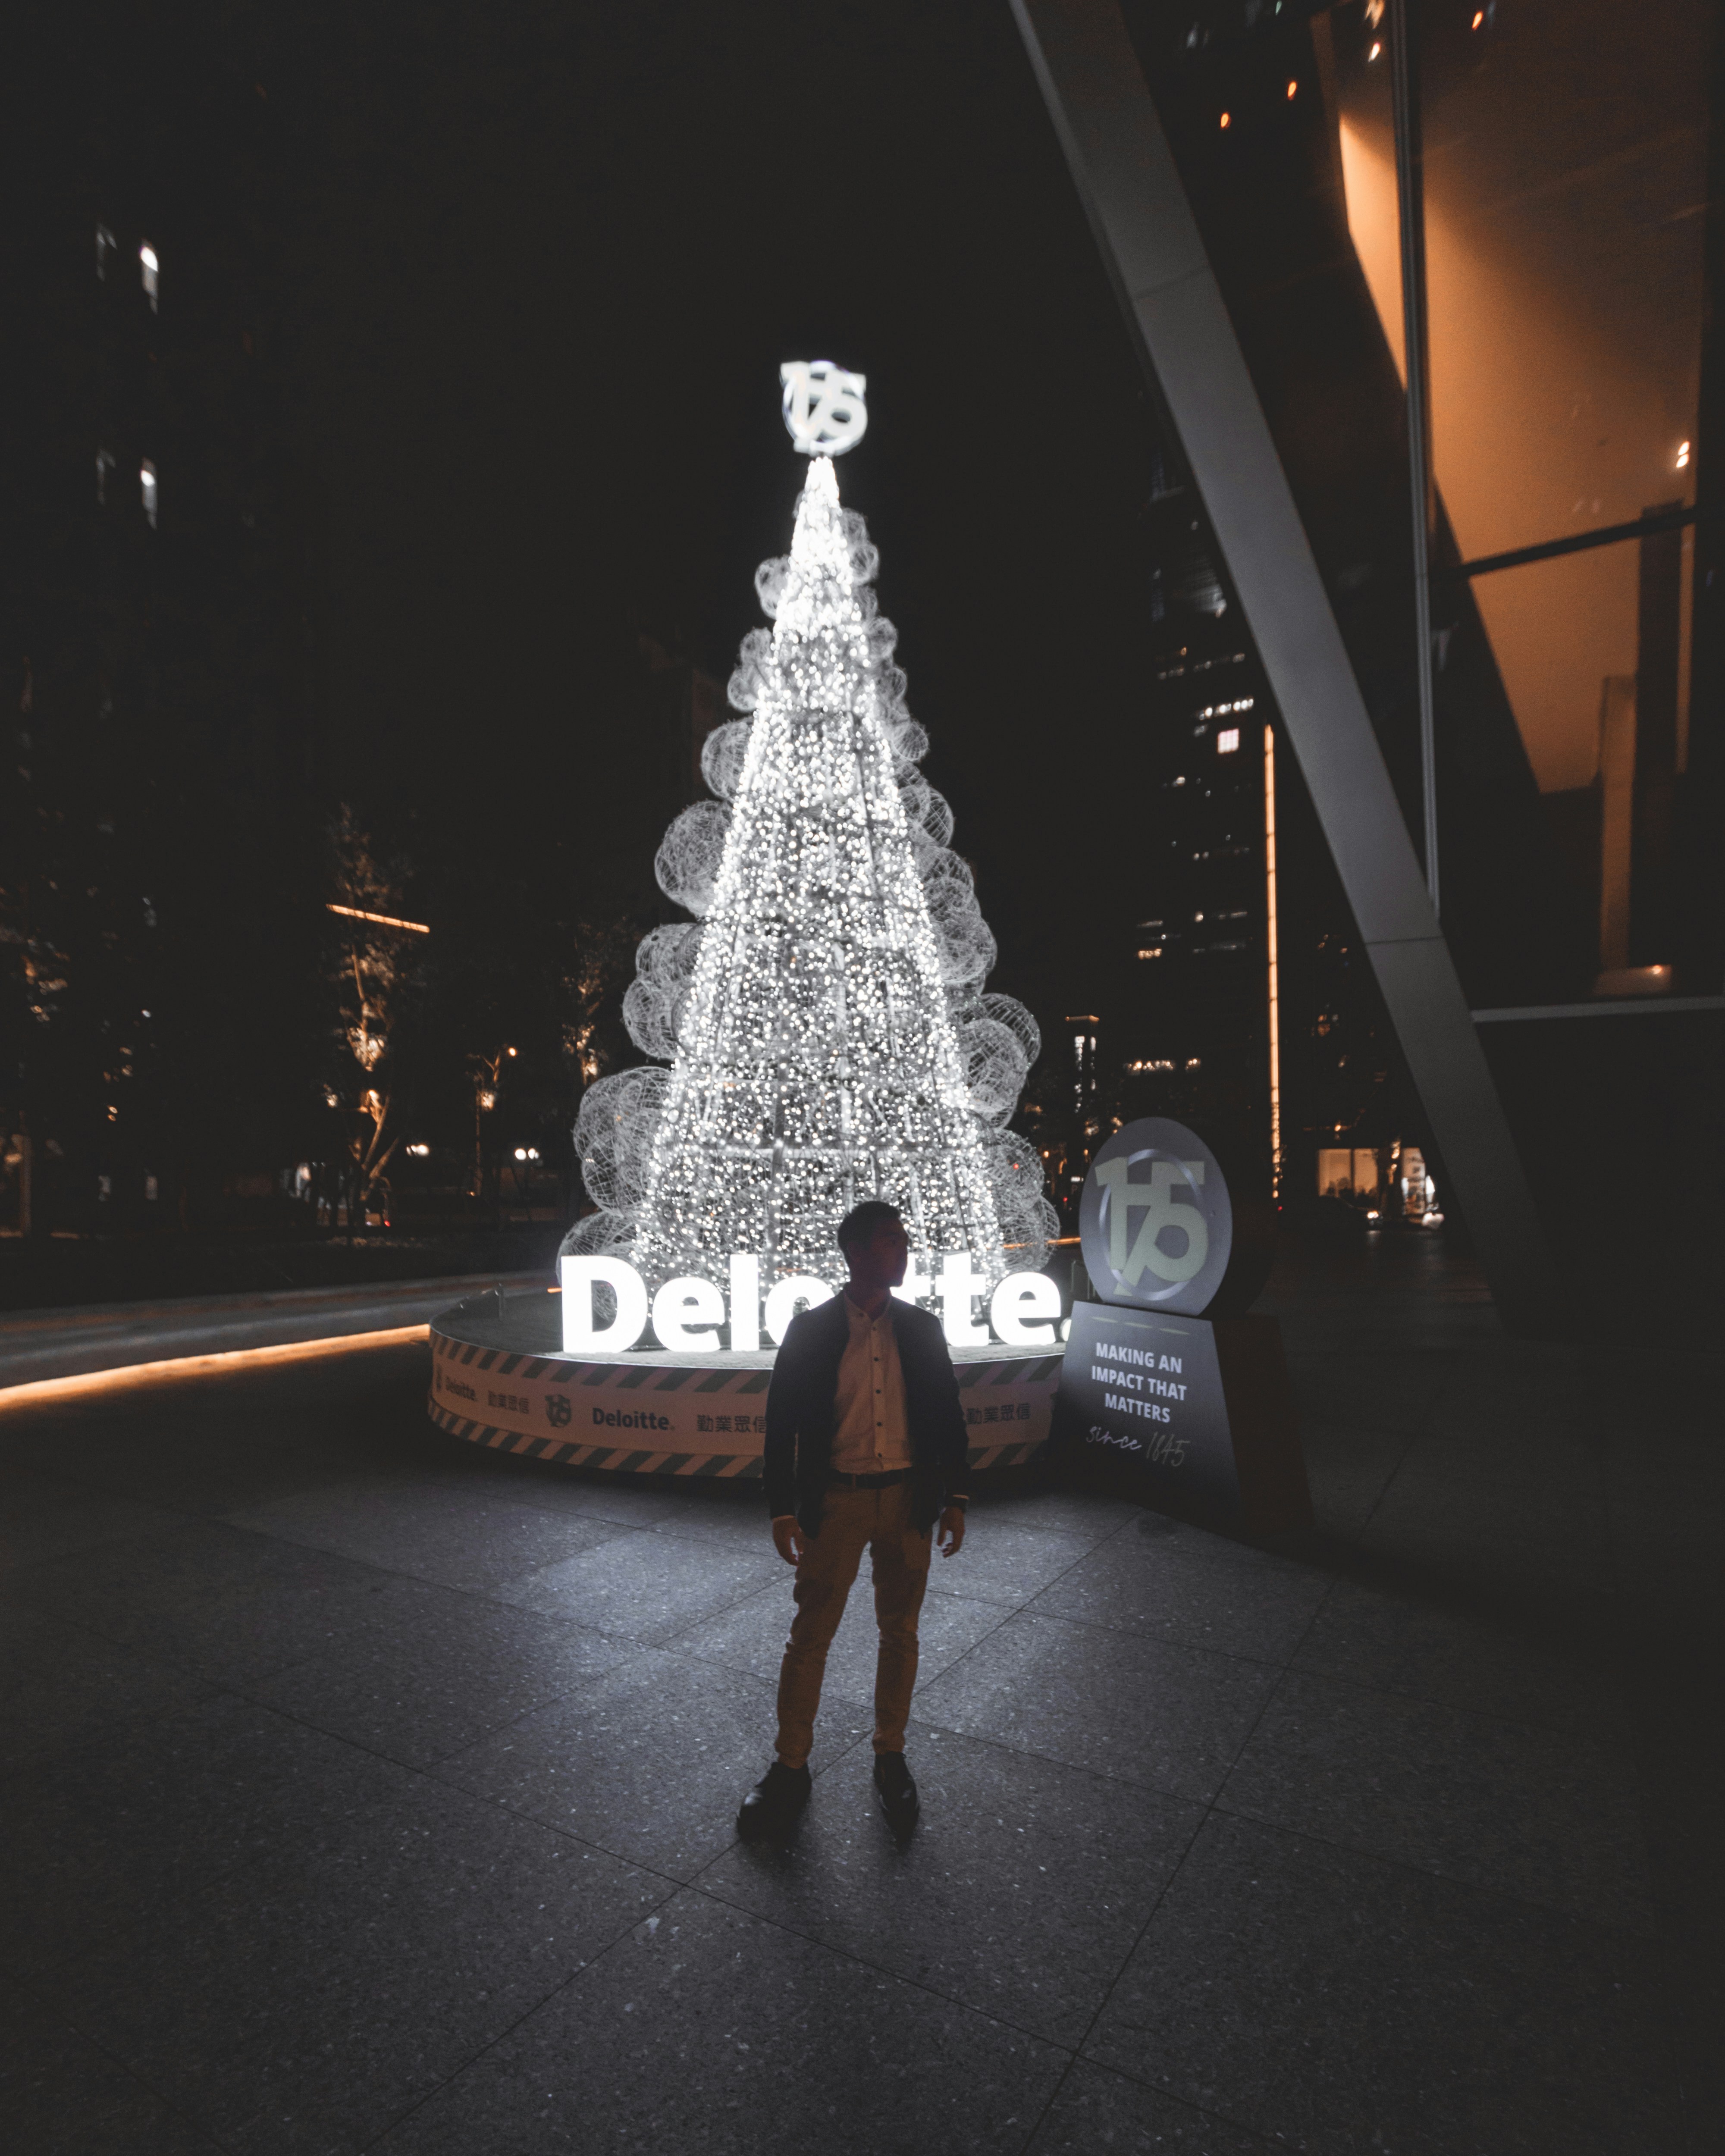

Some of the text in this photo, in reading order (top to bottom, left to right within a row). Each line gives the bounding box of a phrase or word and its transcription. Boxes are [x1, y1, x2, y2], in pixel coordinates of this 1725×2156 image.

[1096, 1342, 1182, 1374] MAKING AN
[1091, 1365, 1187, 1401] IMPACT THAT
[1105, 1393, 1171, 1423] MATTERS
[1086, 1426, 1142, 1450] since
